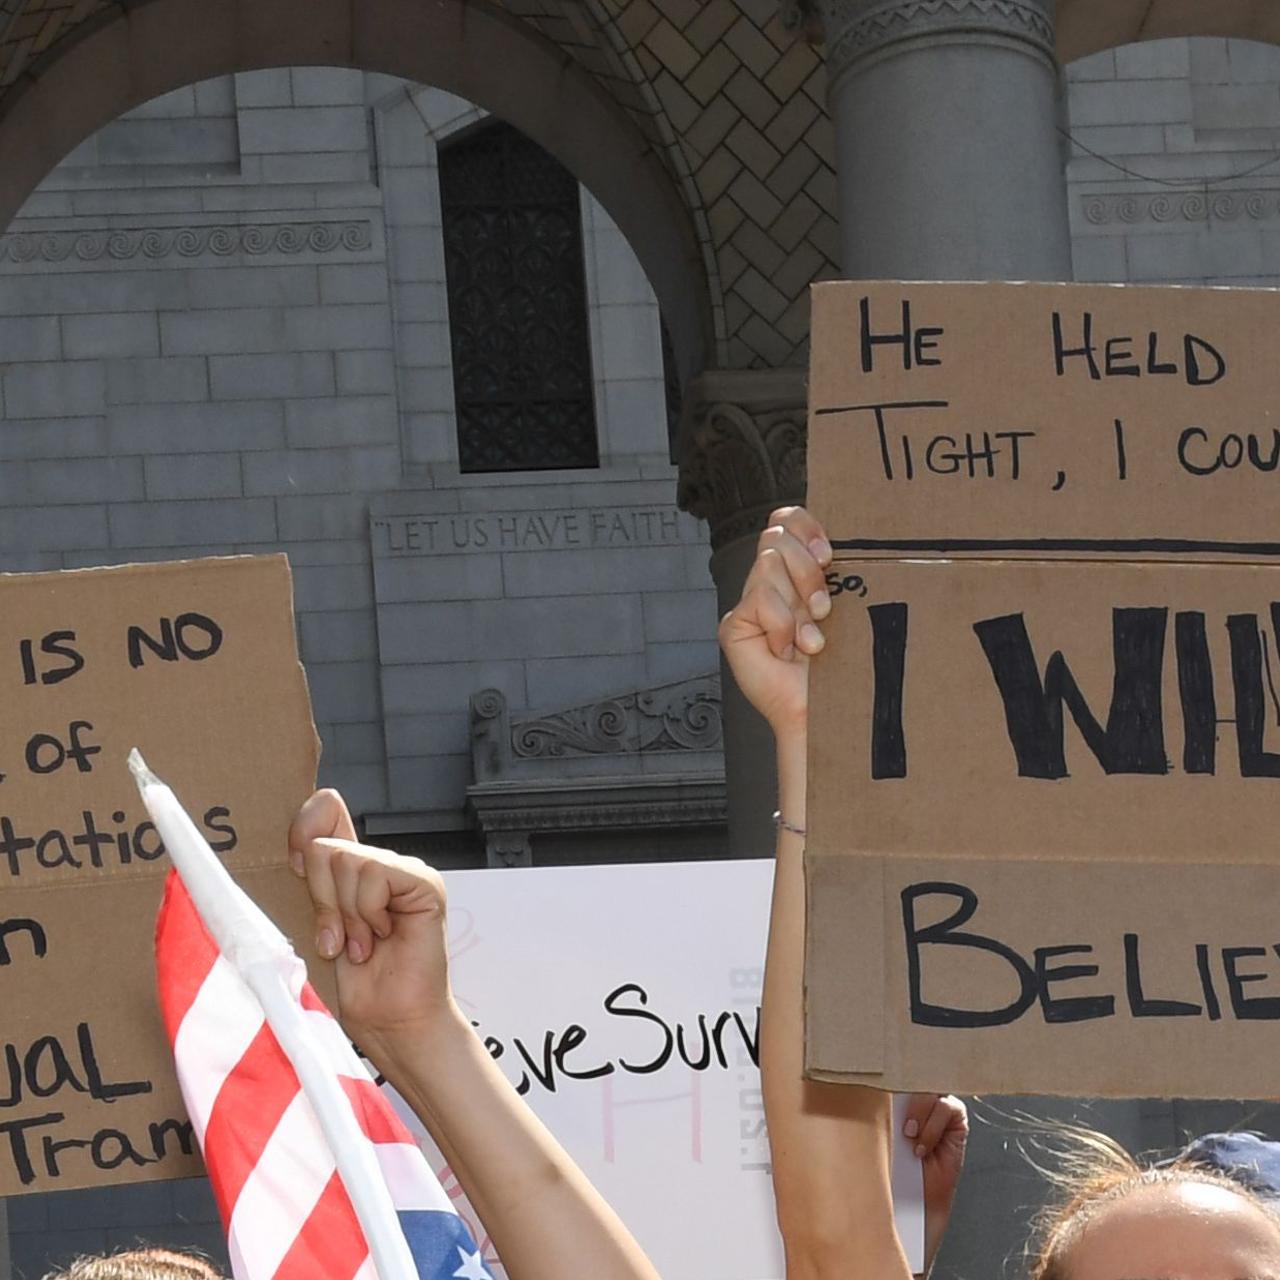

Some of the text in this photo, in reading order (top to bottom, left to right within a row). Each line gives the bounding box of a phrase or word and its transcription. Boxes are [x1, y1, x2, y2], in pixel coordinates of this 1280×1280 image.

[860, 297, 943, 372] HE
[1053, 312, 1225, 385] HELD
[1115, 419, 1125, 480] I
[450, 518, 488, 548] US
[497, 514, 580, 546] HAVE
[591, 511, 679, 543] FAITH
[21, 631, 84, 684] IS
[128, 613, 222, 668] NO
[867, 603, 908, 780] I
[26, 721, 101, 773] of
